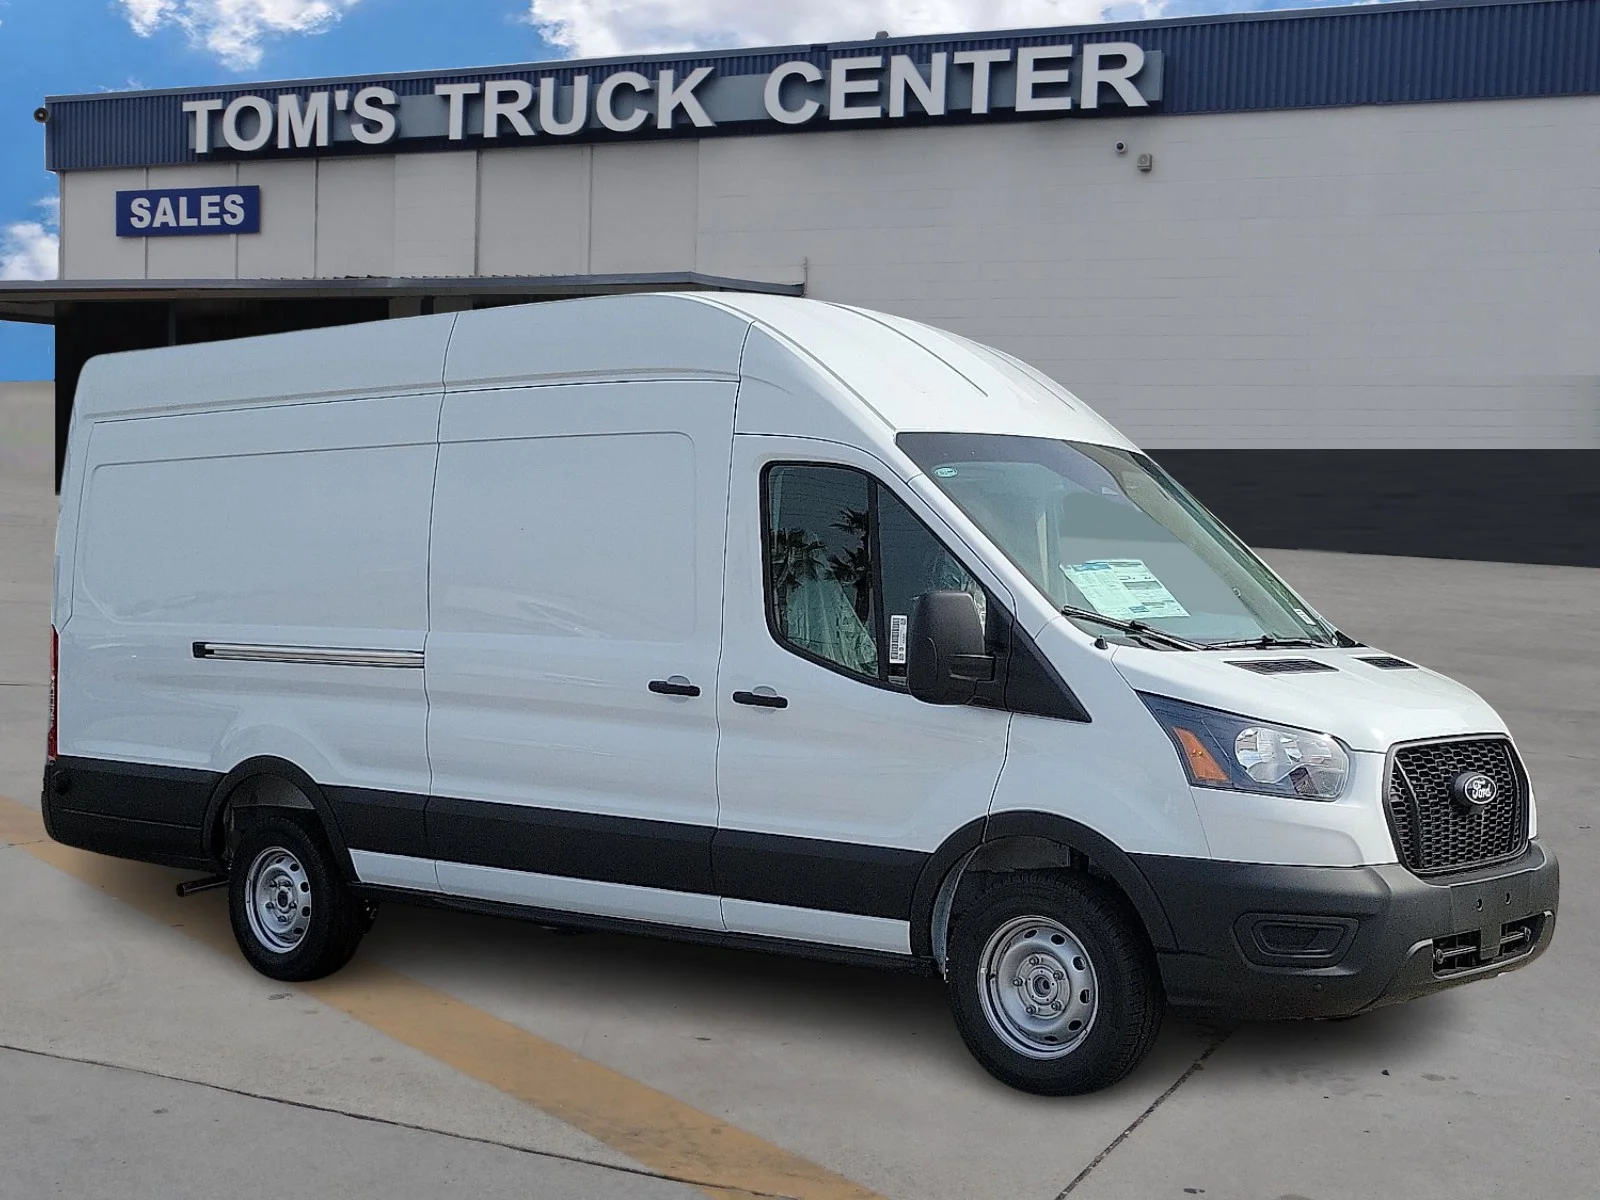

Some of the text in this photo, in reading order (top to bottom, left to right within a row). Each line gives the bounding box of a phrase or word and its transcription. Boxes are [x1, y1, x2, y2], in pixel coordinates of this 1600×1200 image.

[182, 42, 1149, 154] TOM'S TRUCK CENTER
[130, 194, 245, 228] SALES
[1467, 778, 1492, 799] Ford
